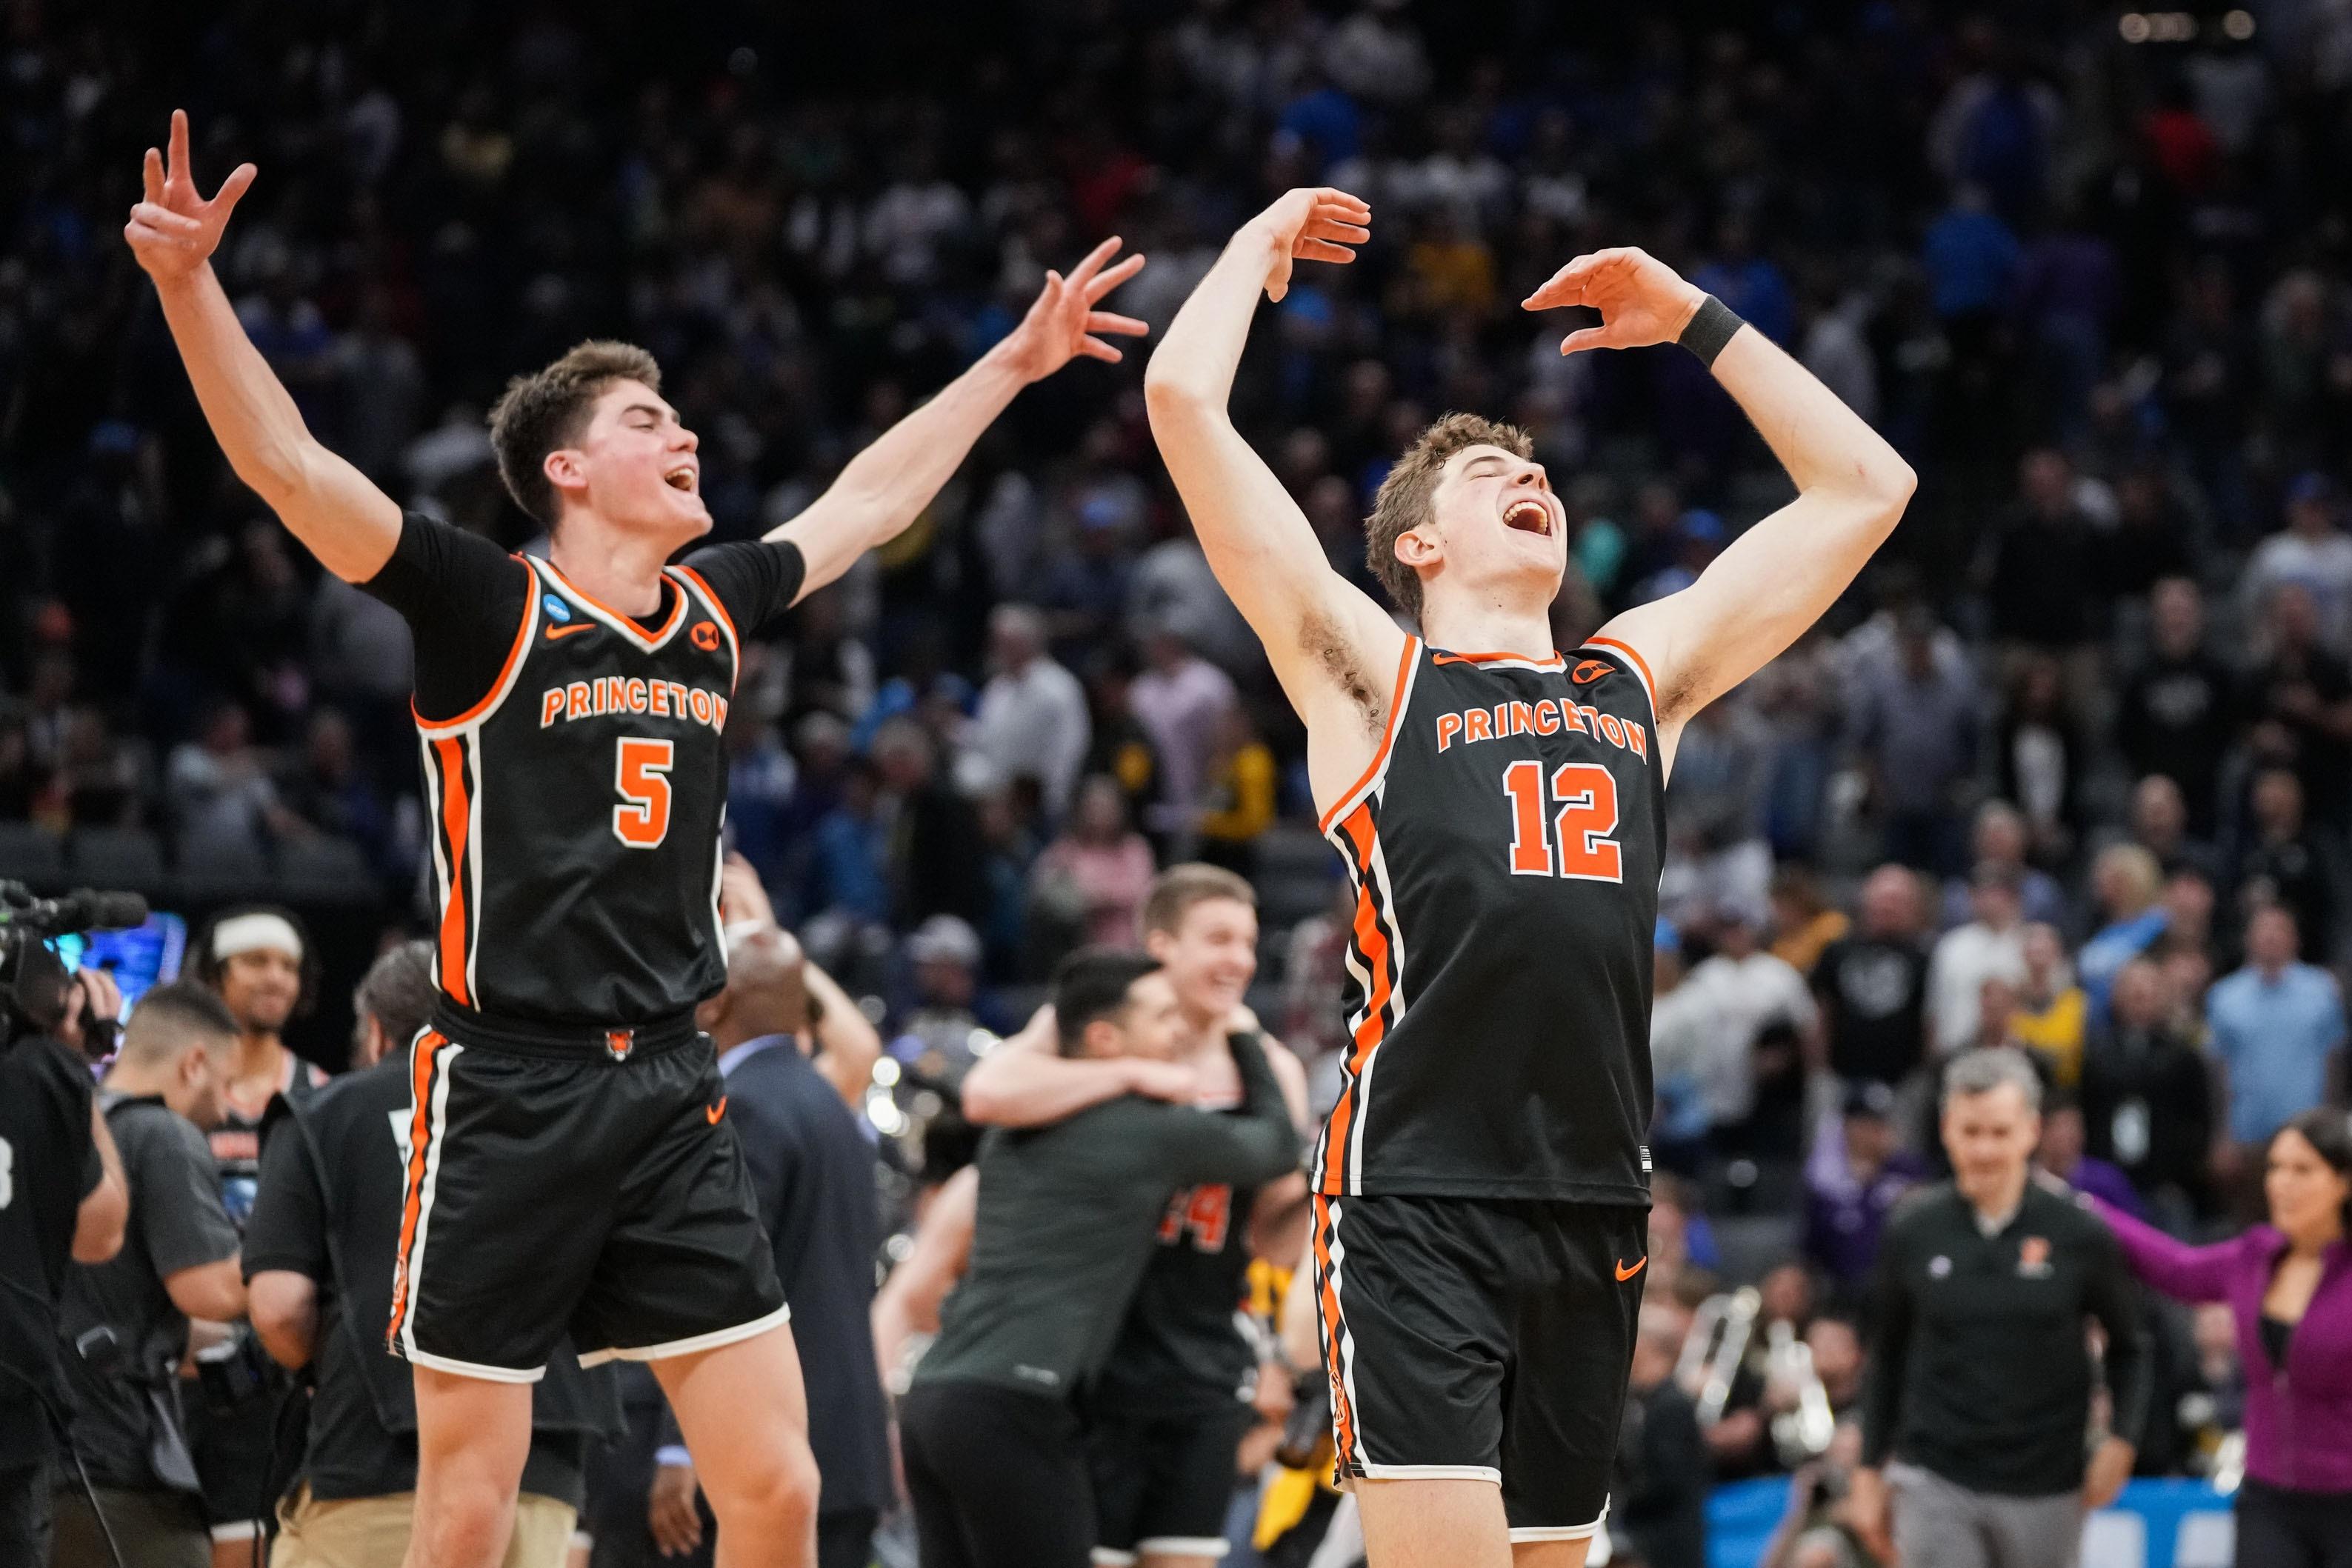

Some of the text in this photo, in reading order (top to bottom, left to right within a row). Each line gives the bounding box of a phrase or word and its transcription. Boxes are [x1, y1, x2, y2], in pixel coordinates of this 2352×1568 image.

[541, 676, 728, 735] PRINCETON
[1436, 698, 1647, 765] PRINCETON
[613, 736, 674, 849] 5
[1502, 761, 1623, 884] 12
